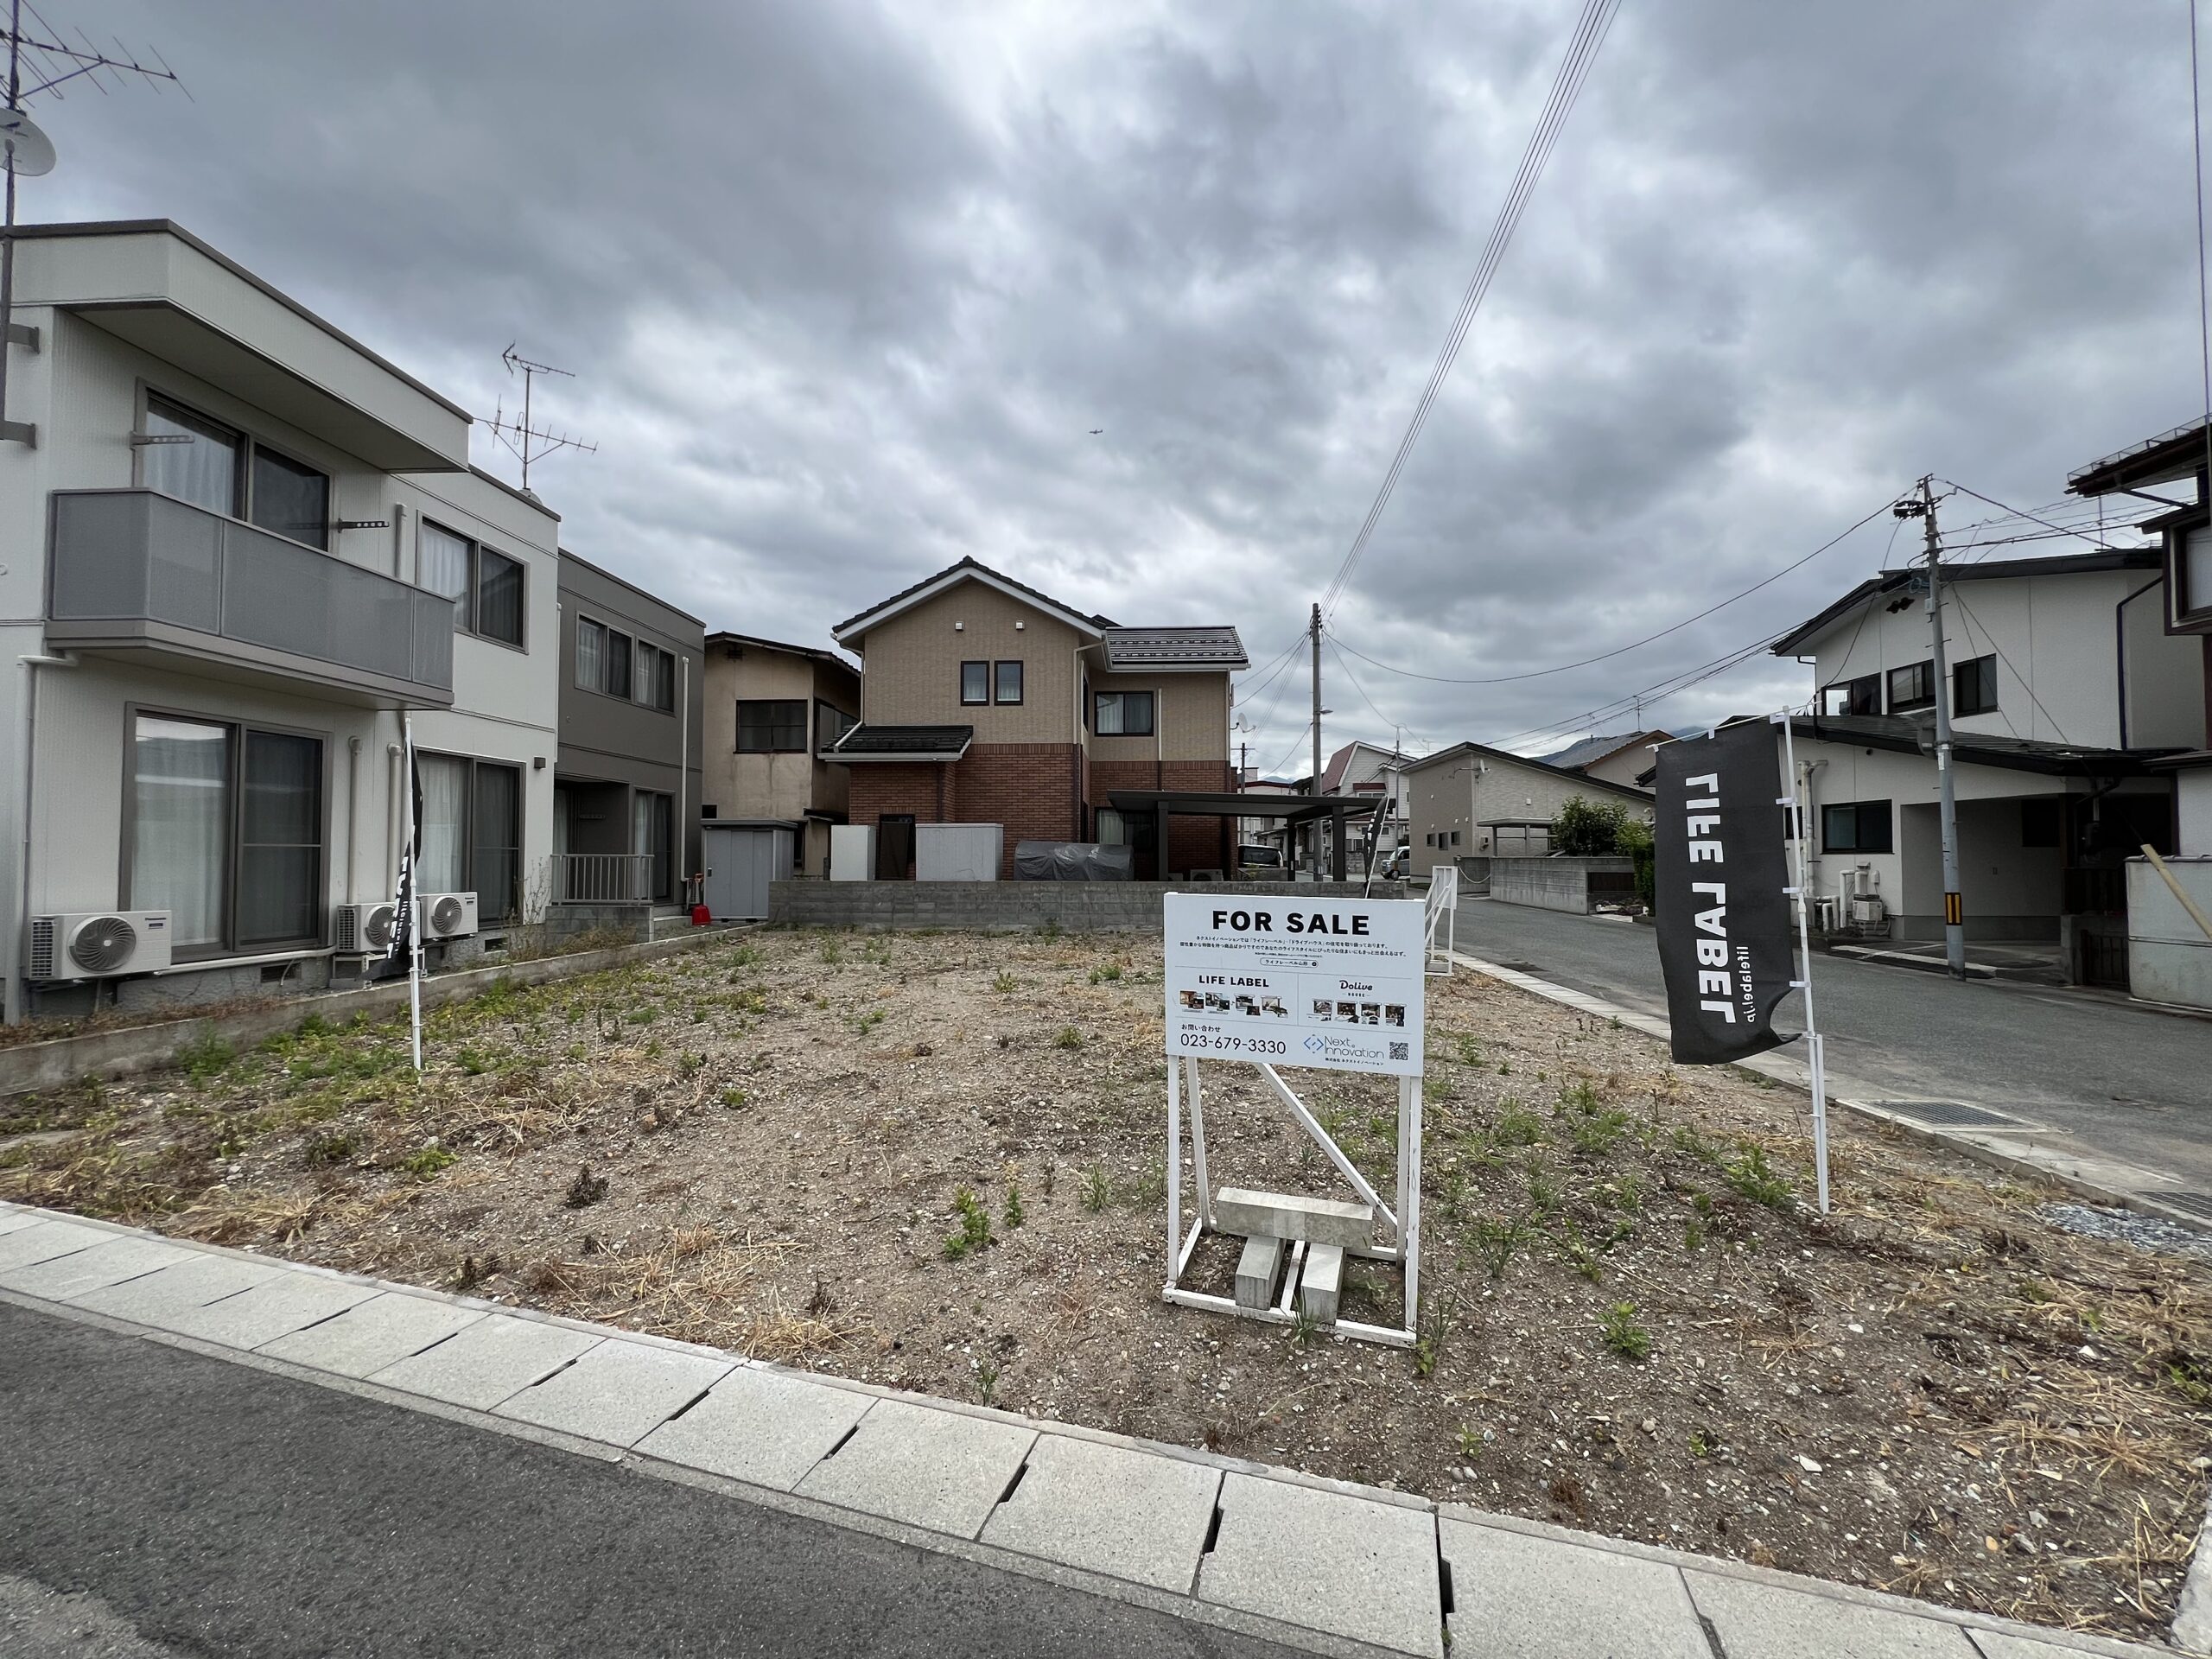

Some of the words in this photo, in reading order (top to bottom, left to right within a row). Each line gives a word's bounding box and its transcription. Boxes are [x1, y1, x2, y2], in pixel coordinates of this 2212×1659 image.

[1212, 910, 1273, 931] FOR
[1287, 912, 1370, 935] SALE
[1199, 975, 1225, 985] LIFE
[1230, 976, 1269, 988] LABEL
[1181, 1023, 1221, 1033] お問い合わせ
[1180, 1033, 1287, 1055] 023-679-3330
[1324, 1045, 1384, 1059] Innovation
